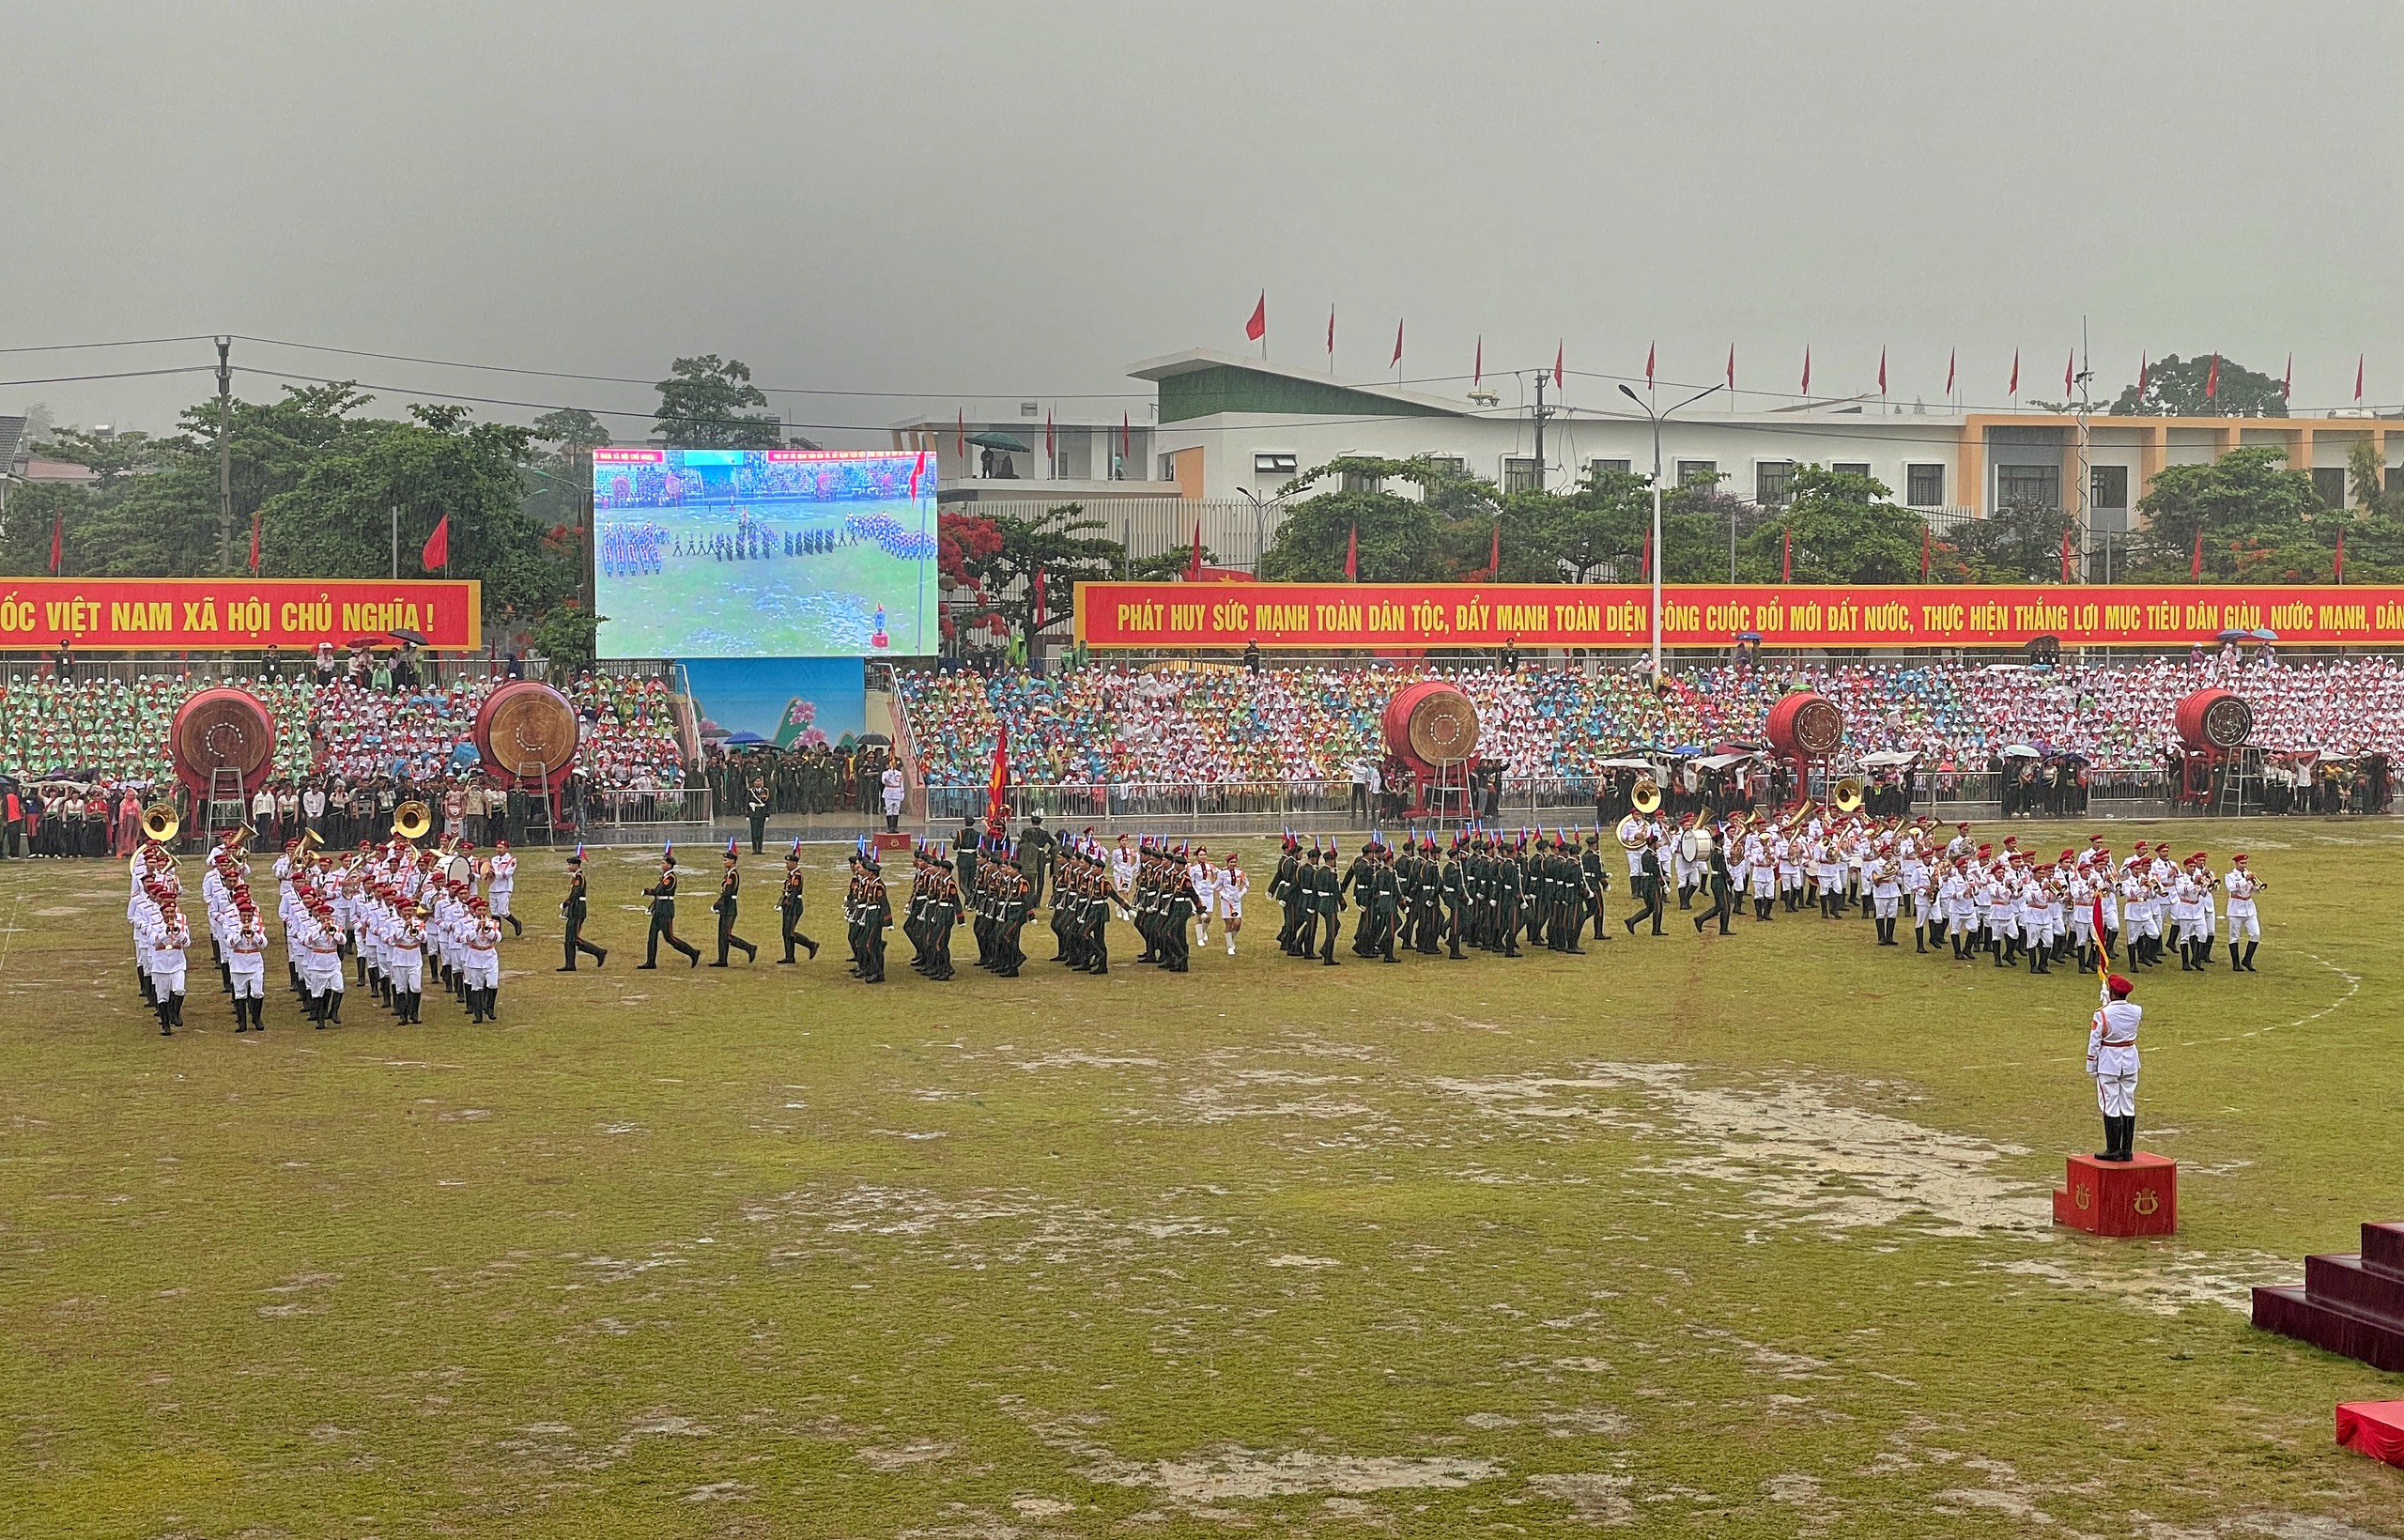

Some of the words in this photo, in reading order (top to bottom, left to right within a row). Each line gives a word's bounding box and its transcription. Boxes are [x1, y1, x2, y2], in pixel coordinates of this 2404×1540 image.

[45, 595, 101, 639] VIỆT
[111, 602, 173, 632] NAM
[182, 596, 219, 632] XÃ
[227, 595, 270, 639] HỘI
[281, 593, 332, 633] CHỦ
[342, 597, 421, 632] NGHĨA
[426, 603, 434, 632] !
[1118, 599, 1163, 631] PHÁT
[1171, 605, 1206, 631] HUY
[1213, 599, 1248, 631] SỨC
[1256, 605, 1308, 637] MẠNH
[1316, 600, 1362, 631] TOÀN
[1369, 600, 1405, 631] DÂN
[1411, 600, 1449, 637] TỘC,
[1456, 594, 1489, 630] ĐẨY
[1497, 605, 1548, 637] MẠNH
[1555, 600, 1599, 631] TOÀN
[1607, 600, 1646, 637] DIỆN
[1706, 600, 1749, 637] CUỘC
[1756, 595, 1783, 631] ĐỔI
[1791, 600, 1821, 631] MỚI
[1827, 597, 1858, 631] ĐẤT
[1865, 600, 1914, 634] NƯỚC,
[1922, 603, 1964, 636] THỰC
[1970, 601, 2008, 636] HIỆN
[2014, 596, 2068, 631] THẮNG
[2074, 603, 2098, 636] LỢI
[2105, 605, 2140, 636] MỤC
[2147, 600, 2180, 630] TIÊU
[2186, 600, 2219, 630] DÂN
[2271, 600, 2313, 630] NƯỚC
[2319, 605, 2369, 636] MẠNH,
